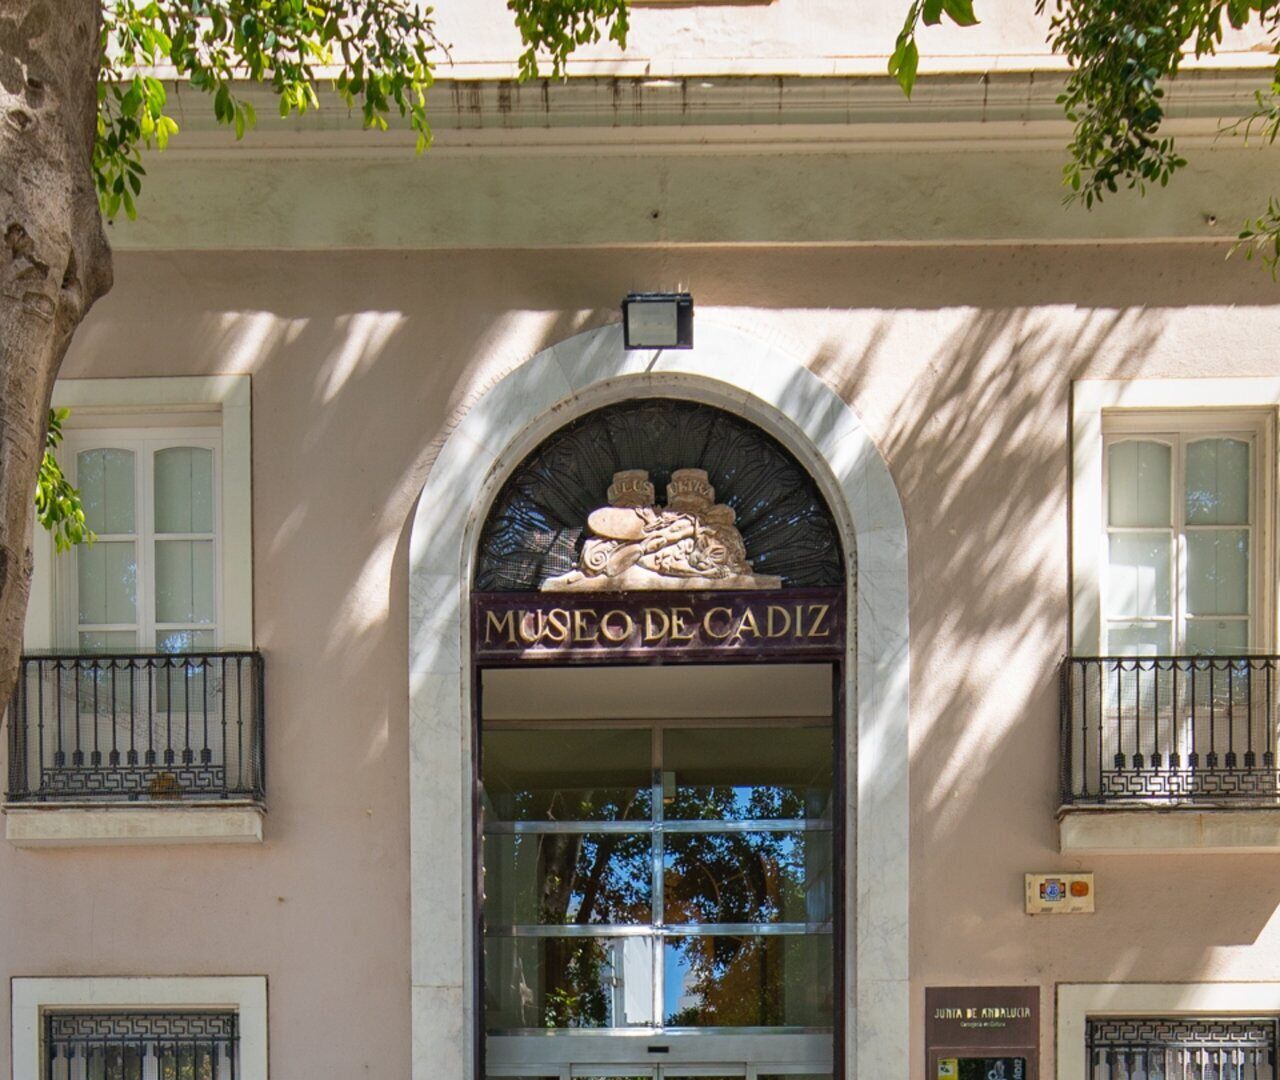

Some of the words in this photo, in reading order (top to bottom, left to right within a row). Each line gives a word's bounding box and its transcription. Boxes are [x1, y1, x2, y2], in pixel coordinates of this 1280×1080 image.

[483, 607, 634, 644] MUSEO
[643, 607, 696, 641] DE
[702, 604, 831, 639] CADIZ
[934, 1007, 963, 1019] JUNTA
[966, 1007, 978, 1018] DE
